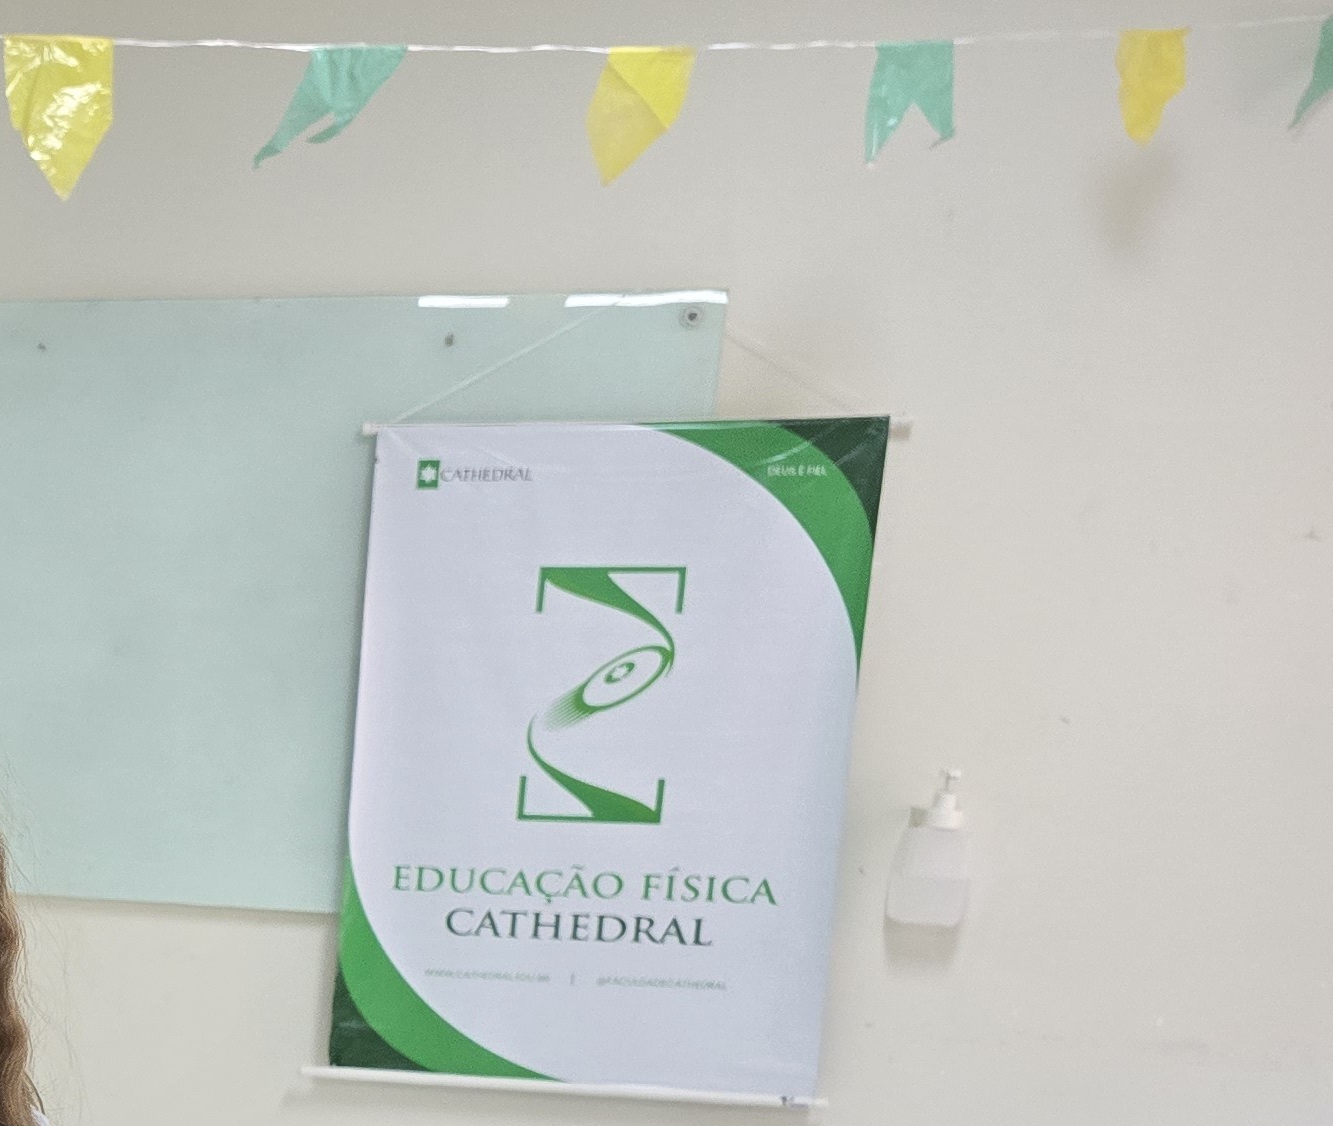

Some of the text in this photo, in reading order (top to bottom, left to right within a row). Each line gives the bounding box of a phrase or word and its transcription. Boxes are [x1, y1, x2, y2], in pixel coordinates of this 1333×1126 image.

[440, 466, 532, 482] CATHEDRAL
[393, 865, 779, 905] EDUCAÇÃO FÍSICA
[445, 908, 712, 947] CATHEDRAL
